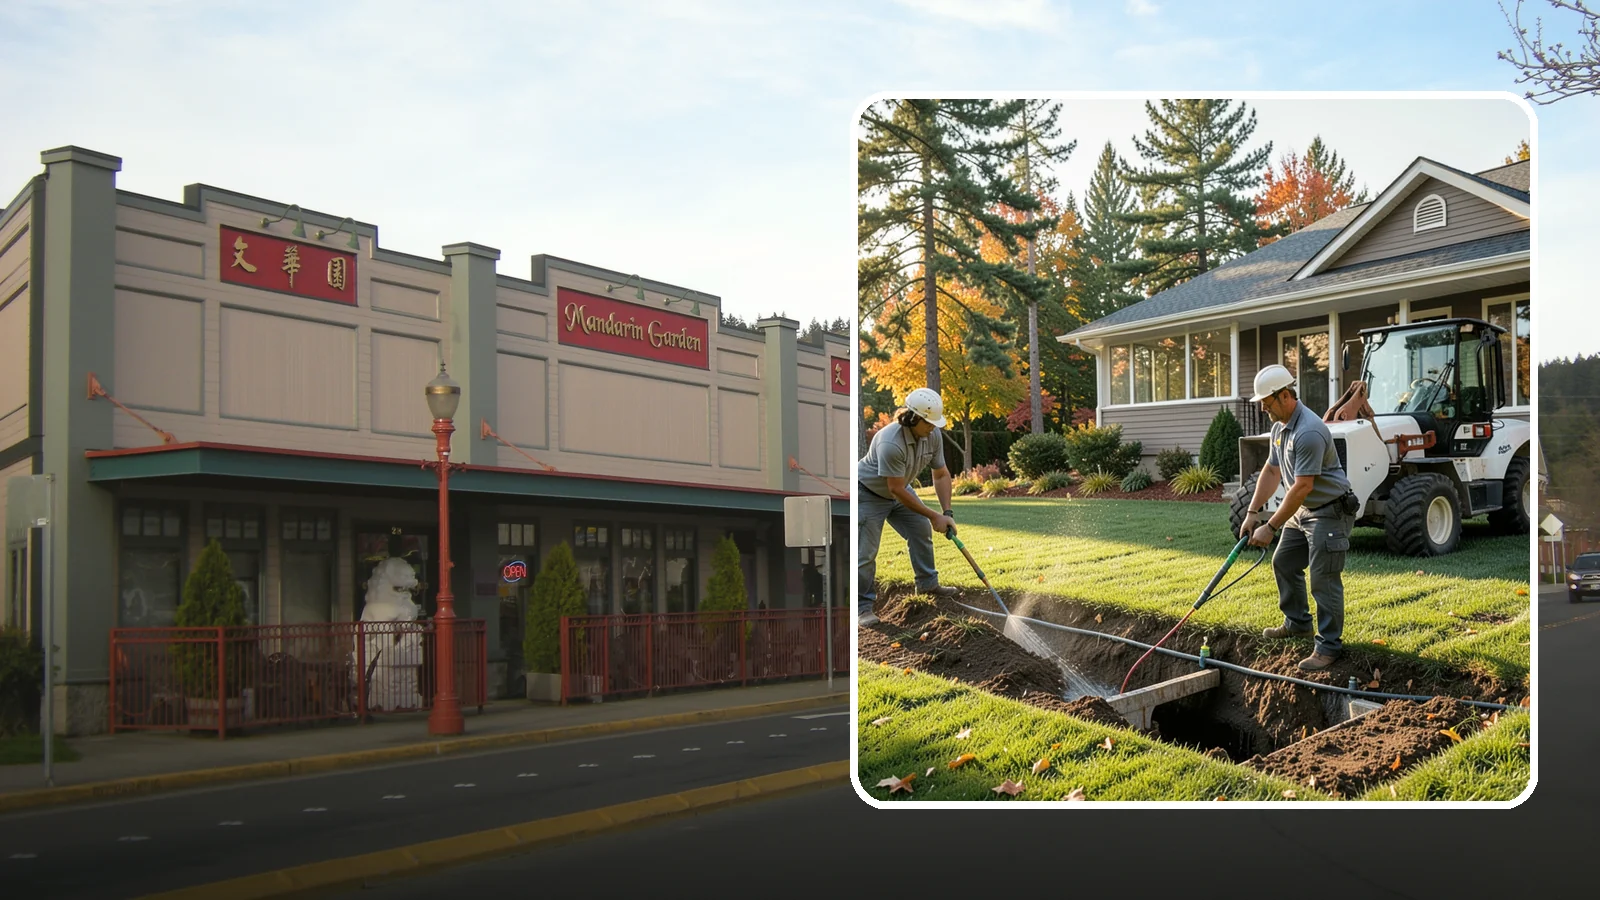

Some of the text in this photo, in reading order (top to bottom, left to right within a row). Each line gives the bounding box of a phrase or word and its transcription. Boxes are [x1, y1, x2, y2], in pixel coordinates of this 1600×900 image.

[231, 236, 346, 291] 文華園
[564, 302, 701, 353] Mandarin Garden
[835, 363, 847, 386] 文
[503, 565, 527, 578] OPEN
